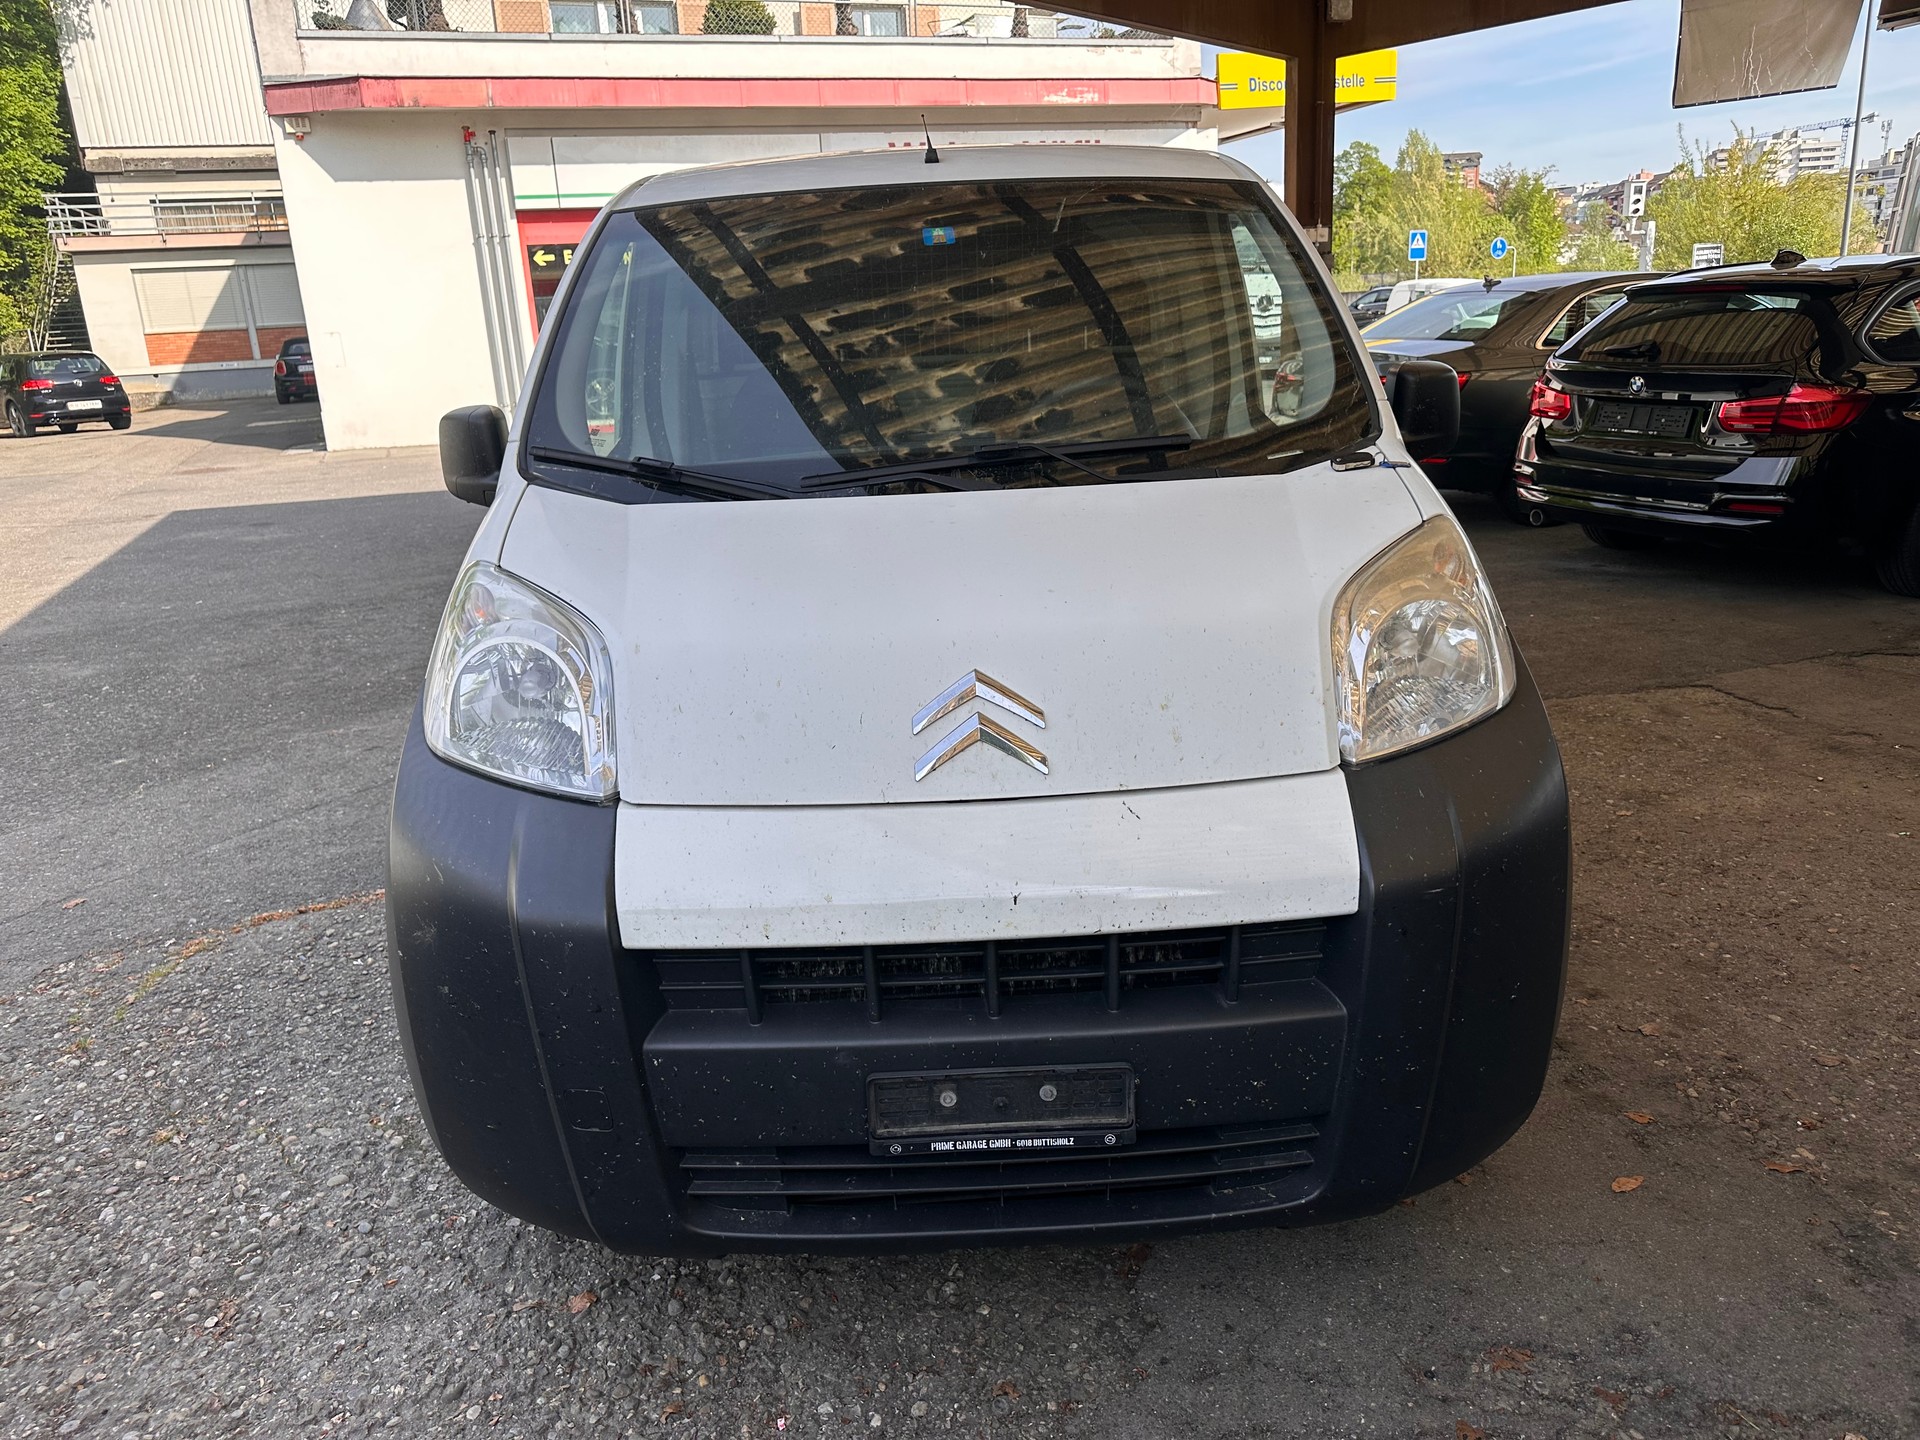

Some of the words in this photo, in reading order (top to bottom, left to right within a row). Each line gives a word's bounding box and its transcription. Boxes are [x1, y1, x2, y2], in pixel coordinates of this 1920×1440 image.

[1249, 77, 1286, 92] Disco
[930, 1142, 954, 1151] PRIME
[956, 1140, 987, 1150] GARAGE
[988, 1138, 1011, 1148] GMBH
[1016, 1139, 1032, 1147] 6018
[1033, 1137, 1074, 1147] BUTTISHOLZ
